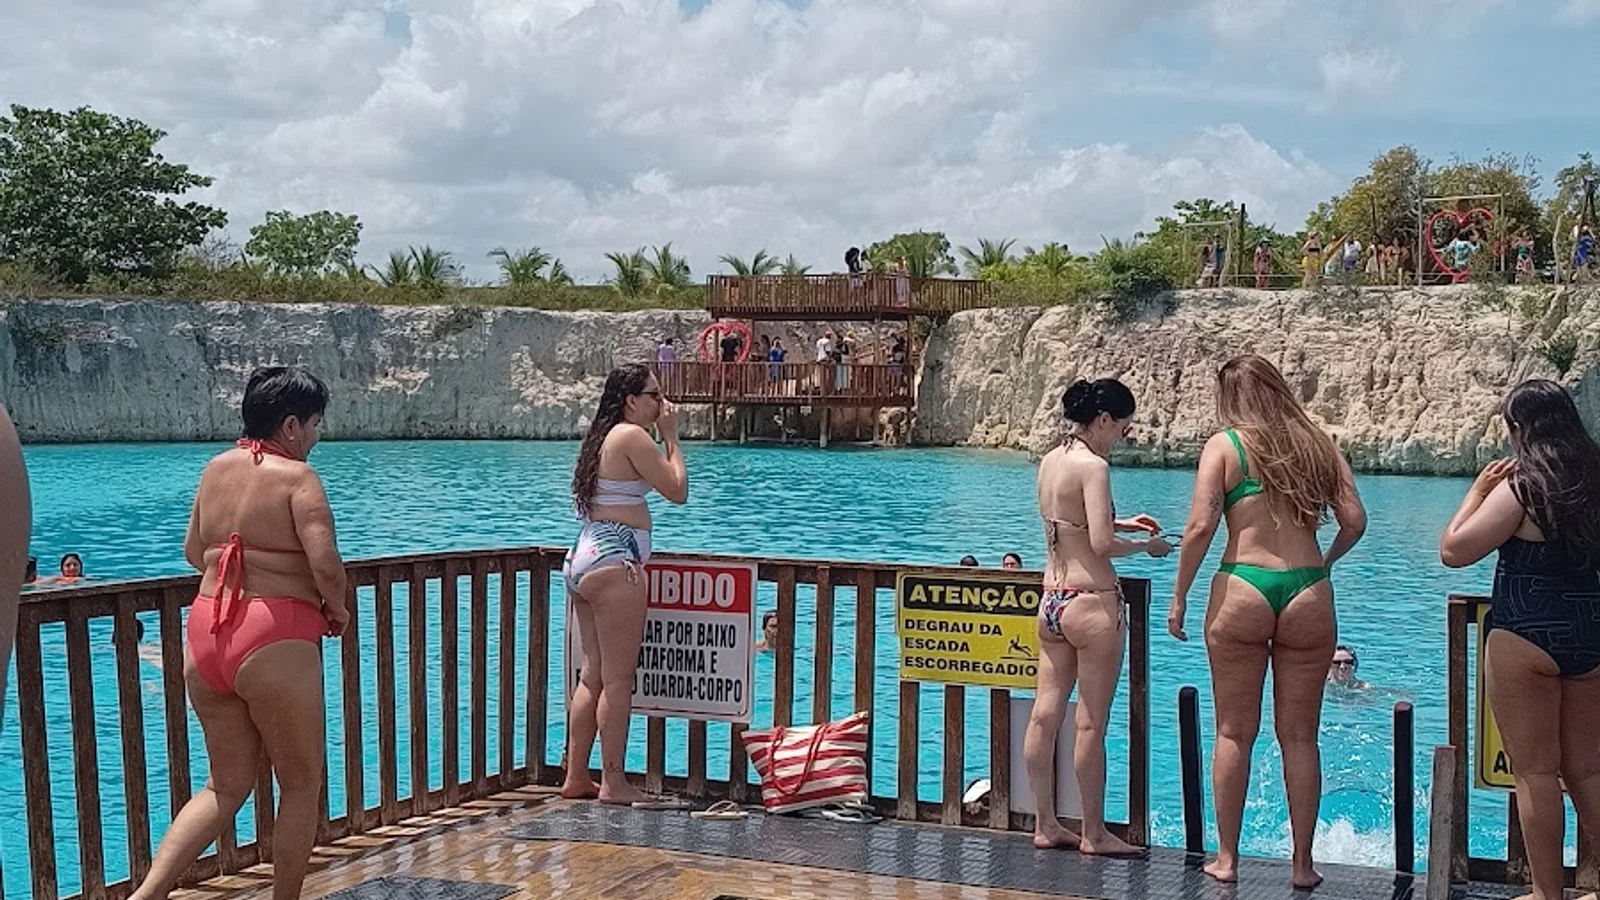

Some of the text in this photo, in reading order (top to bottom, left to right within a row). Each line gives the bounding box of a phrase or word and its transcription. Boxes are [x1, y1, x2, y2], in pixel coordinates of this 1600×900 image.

[651, 569, 735, 607] IBIDO
[909, 584, 1039, 611] ATENÇÃO
[642, 620, 736, 648] AR POR BAIXO
[905, 619, 1002, 636] DEGRAU DA
[905, 638, 970, 652] ESCADA
[637, 646, 717, 673] ATAFORMA E
[905, 656, 1038, 676] ESCORREGADIO
[643, 672, 743, 703] GUARDA-CORPO
